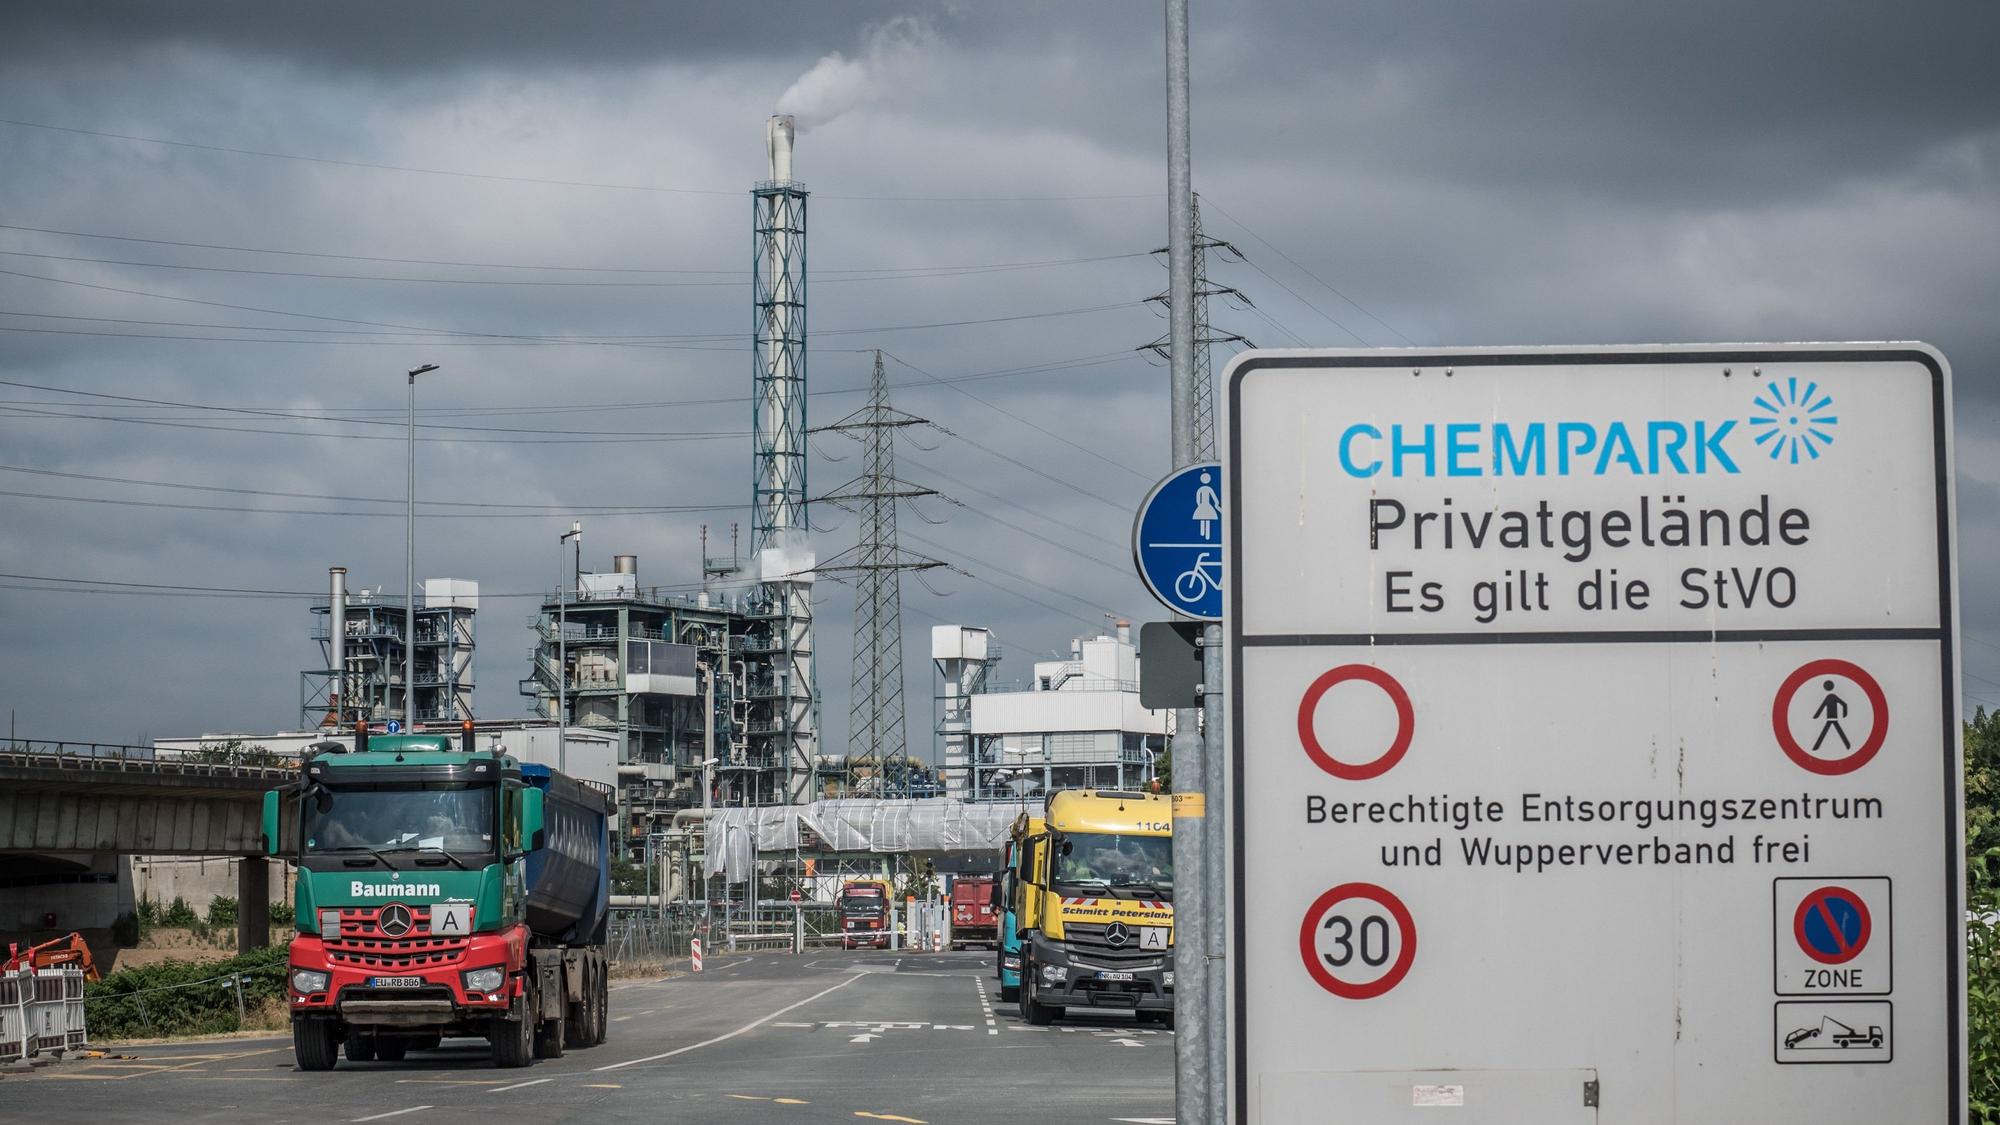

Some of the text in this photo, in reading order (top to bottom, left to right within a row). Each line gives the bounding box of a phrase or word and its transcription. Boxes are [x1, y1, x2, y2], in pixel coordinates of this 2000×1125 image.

[1339, 419, 1740, 479] CHEMPARK
[1370, 494, 1810, 563] Privatgelände
[1386, 566, 1797, 624] Es gilt die StVO
[1306, 792, 1883, 831] Berechtigte Entsorgungszentrum
[1381, 833, 1810, 874] und Wupperverband frei
[351, 881, 440, 897] Baumann
[442, 911, 459, 931] A
[1062, 907, 1109, 916] Schmitt
[1147, 931, 1159, 946] A
[1323, 915, 1390, 966] 30
[1804, 968, 1863, 989] ZONE
